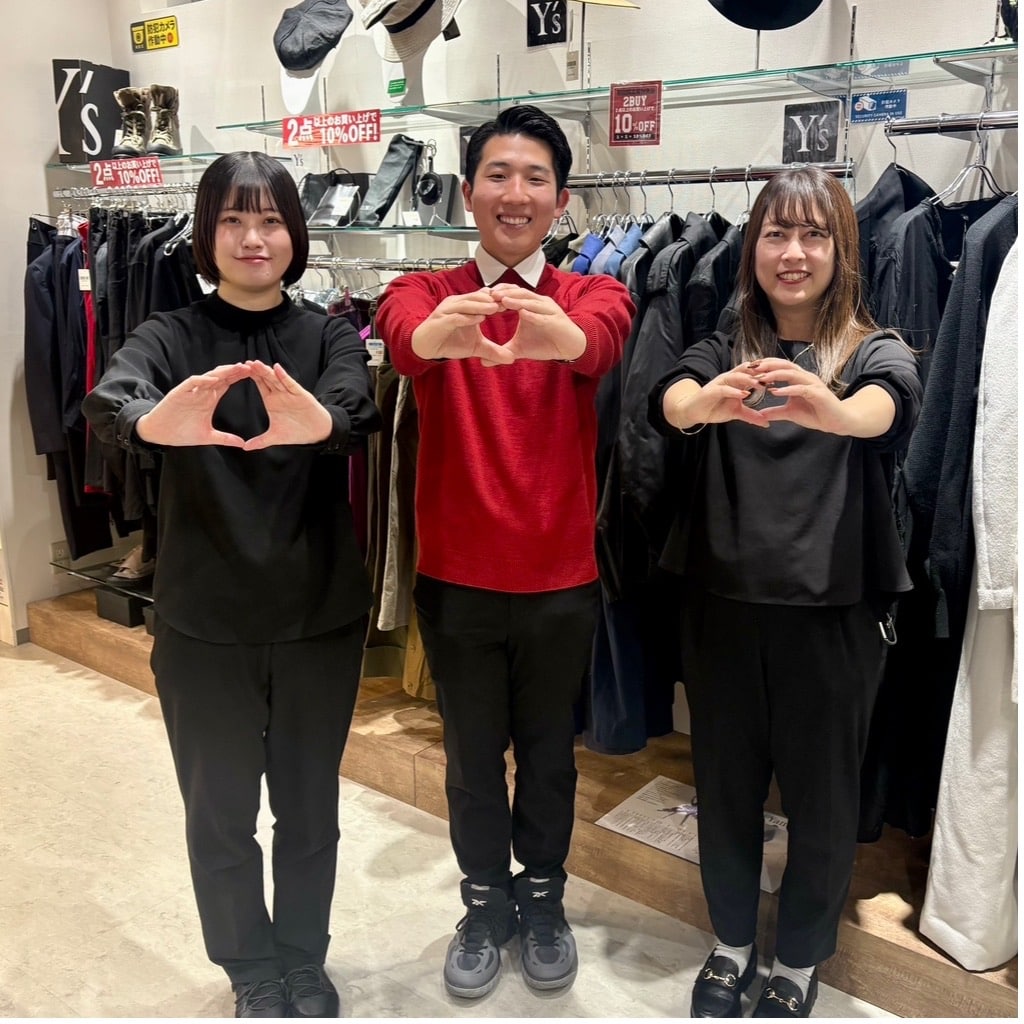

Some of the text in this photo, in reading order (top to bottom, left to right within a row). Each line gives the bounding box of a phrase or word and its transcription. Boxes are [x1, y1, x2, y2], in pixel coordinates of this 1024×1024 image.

[530, 1, 562, 36] Y's
[623, 95, 647, 107] 2BUY
[321, 123, 377, 144] 10%OFF!
[789, 114, 829, 152] Y's
[118, 168, 161, 184] 10%OFF!
